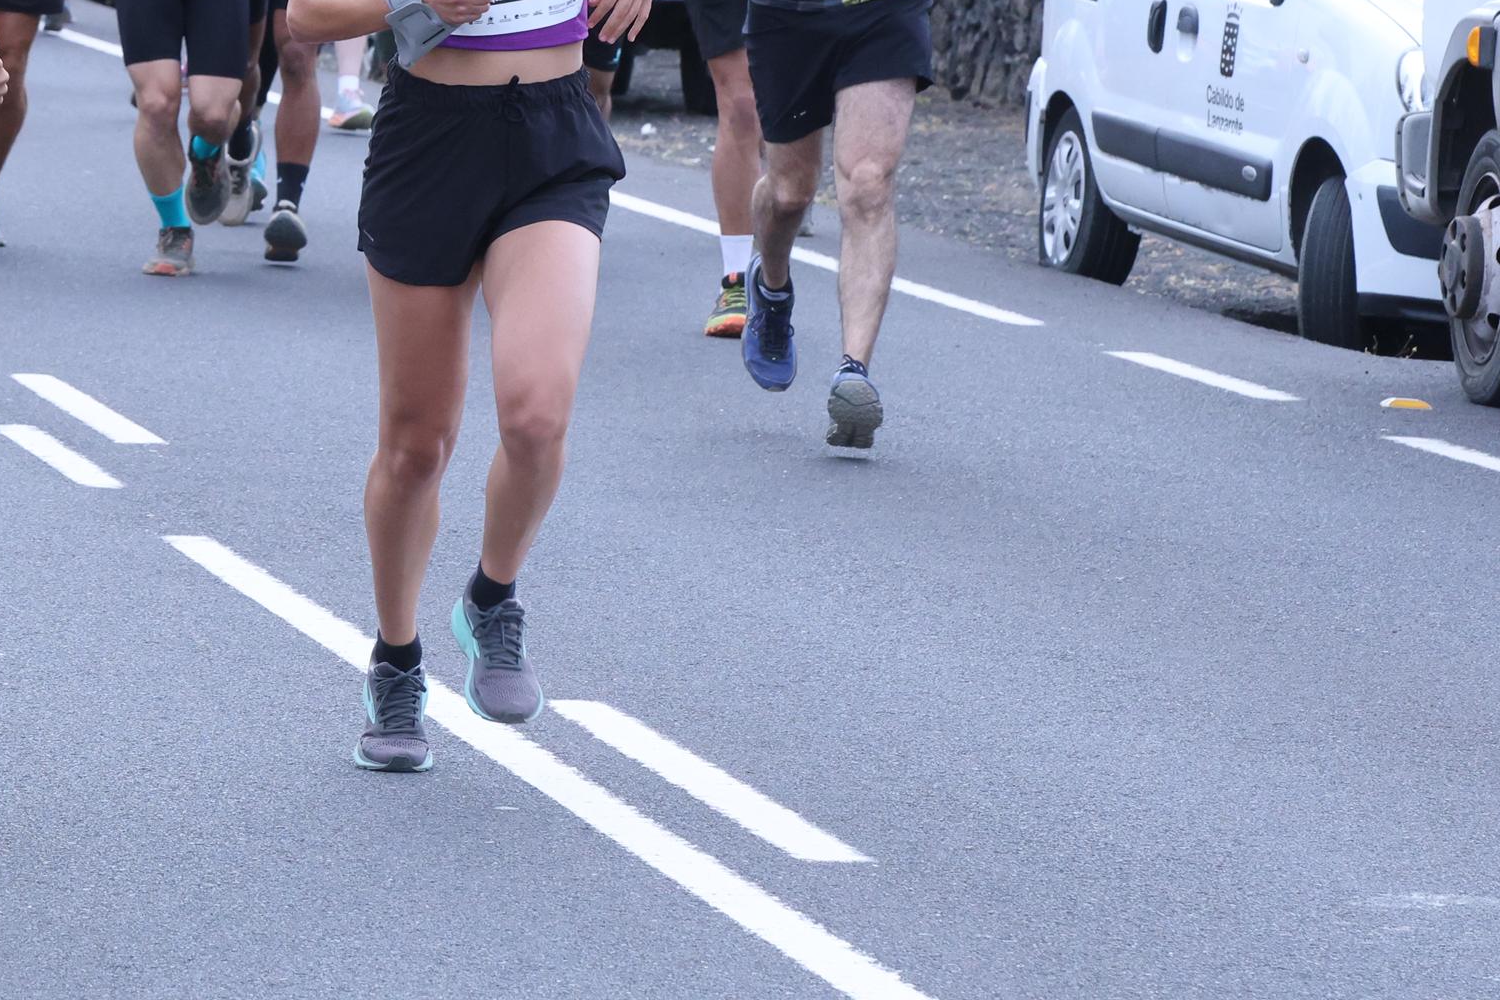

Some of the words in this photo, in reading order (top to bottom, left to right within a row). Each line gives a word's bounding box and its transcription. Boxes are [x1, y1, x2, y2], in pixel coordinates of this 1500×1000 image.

[1206, 84, 1234, 109] Cabildo
[1234, 92, 1244, 112] de
[1207, 108, 1244, 136] Lanzarote
